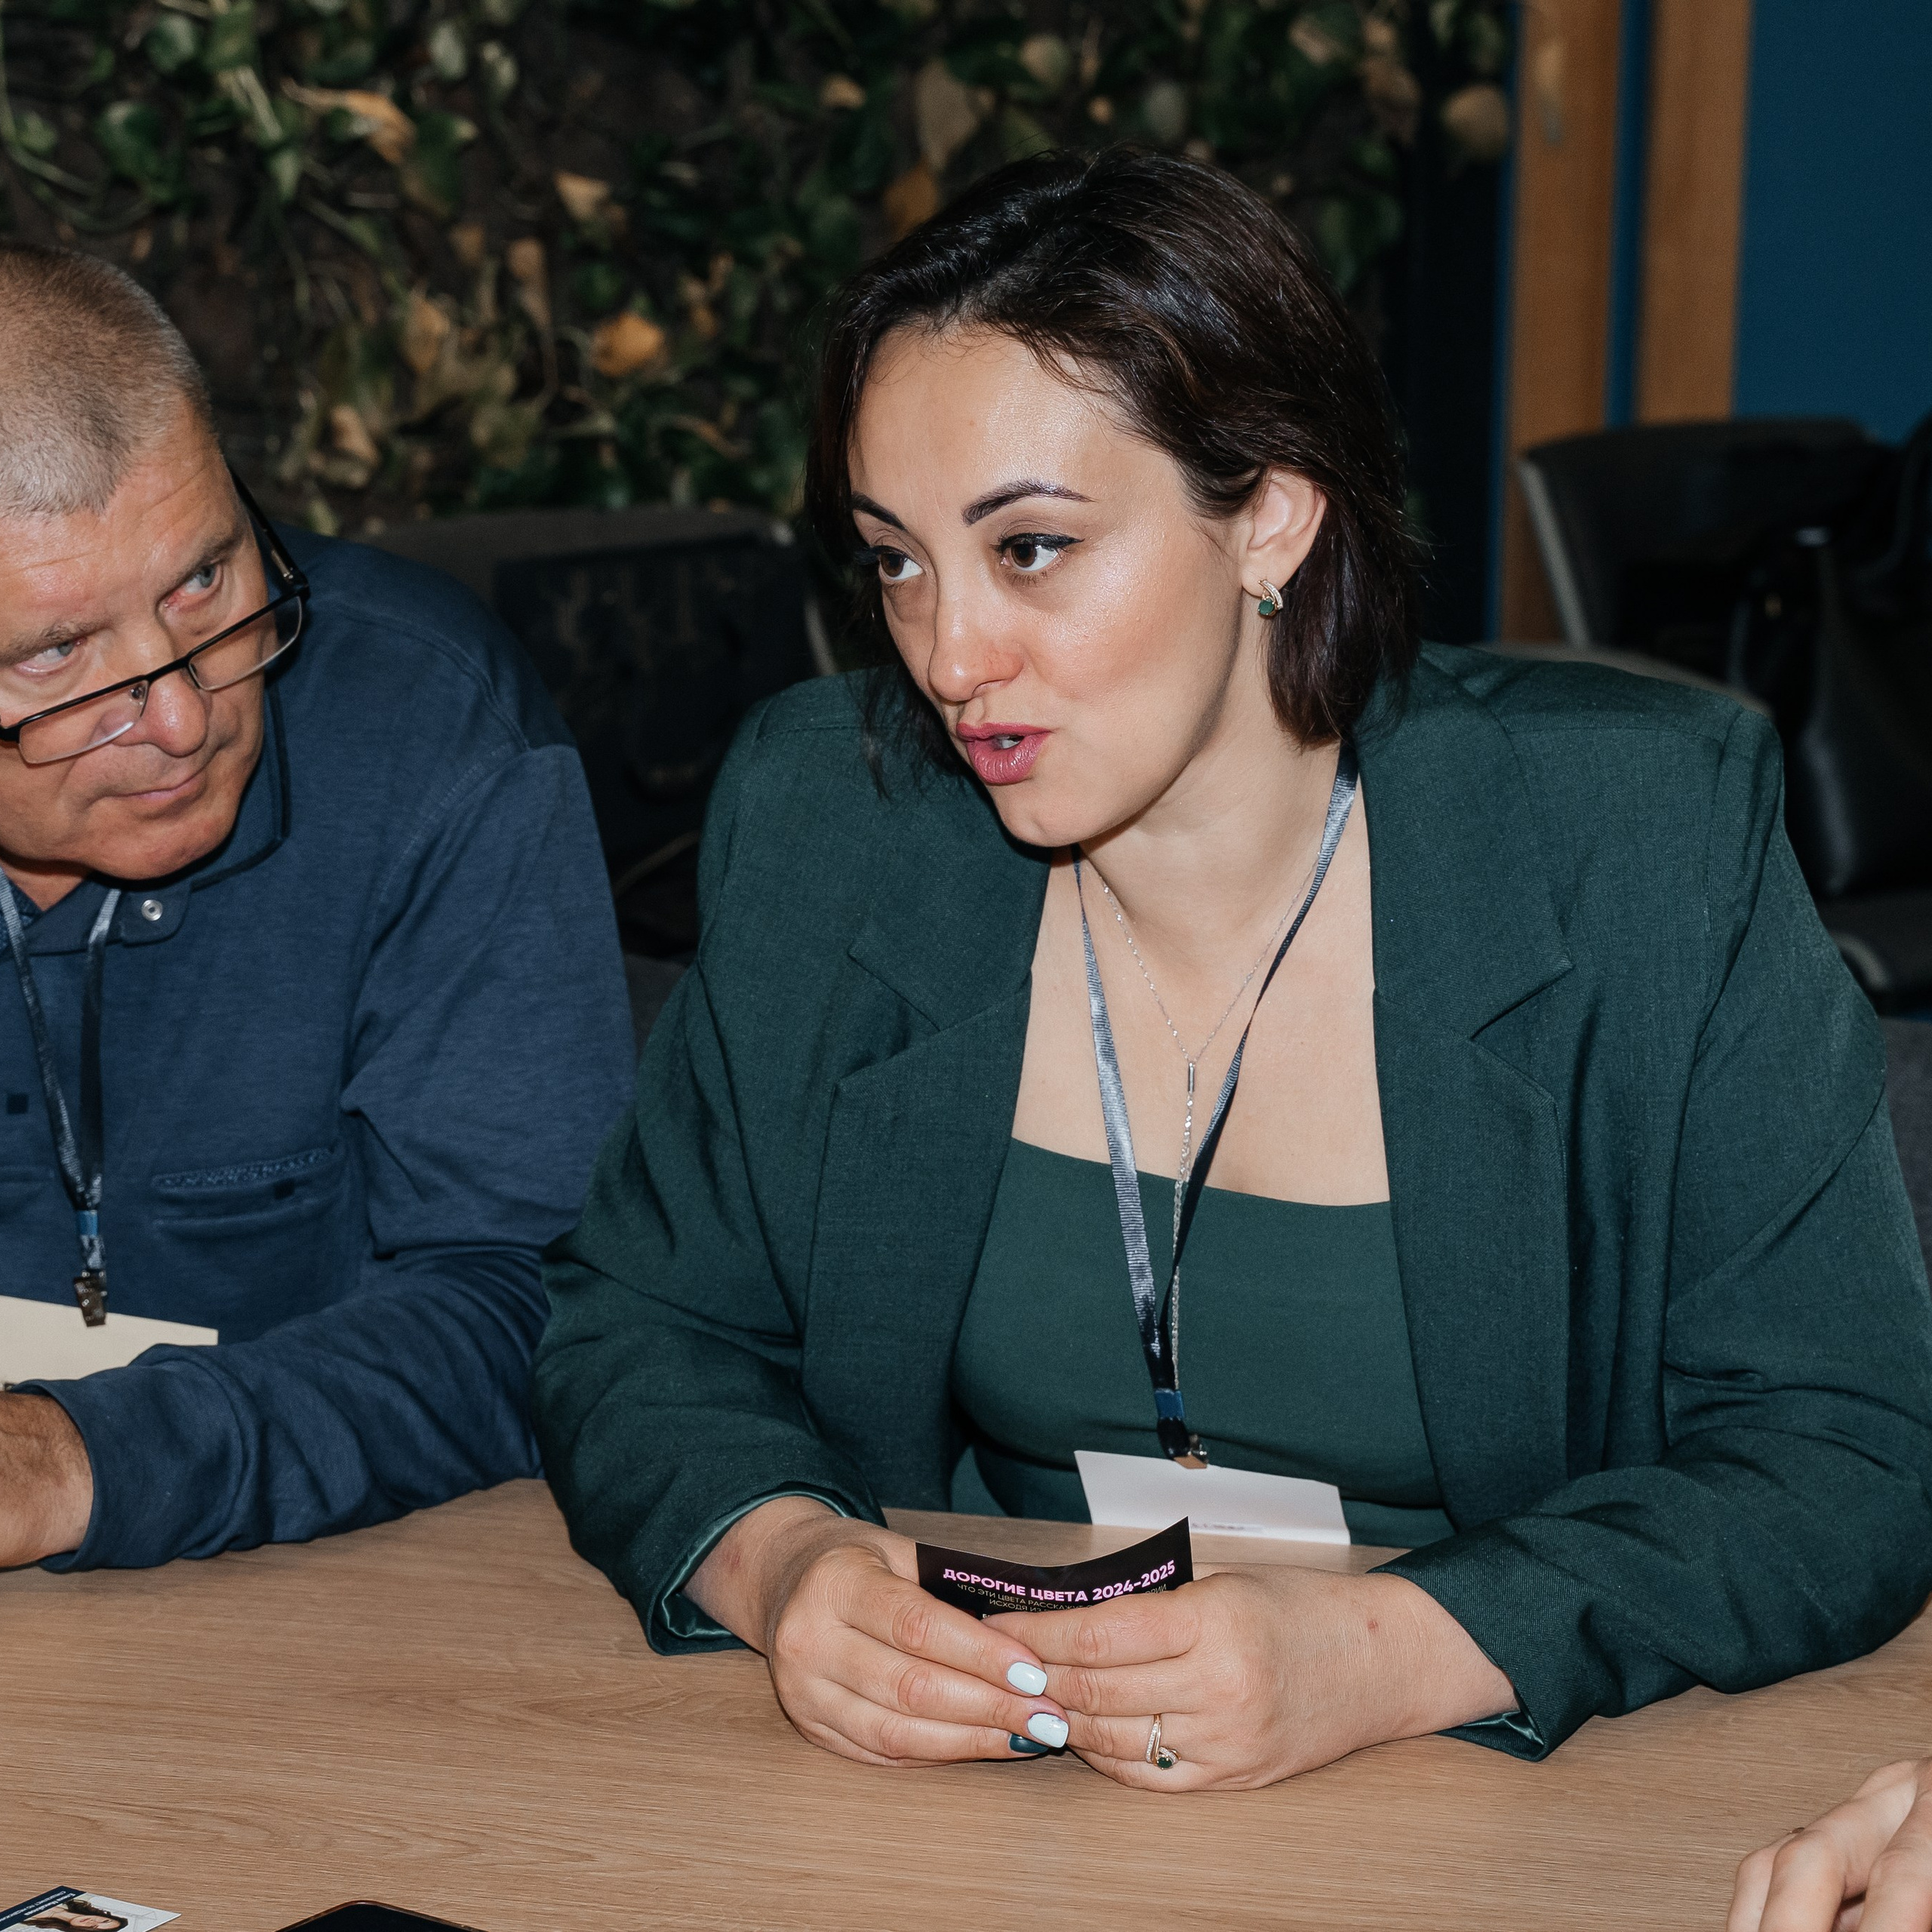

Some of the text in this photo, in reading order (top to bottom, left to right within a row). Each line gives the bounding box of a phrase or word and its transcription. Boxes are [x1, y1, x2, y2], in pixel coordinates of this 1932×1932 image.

[943, 1560, 1176, 1602] ДОРОГИЕ ЦВЕТА 2024-2025
[957, 1583, 976, 1593] ЧТО
[977, 1589, 996, 1598] ЭТИ
[998, 1594, 1026, 1604] ЦВЕТА
[989, 1598, 1028, 1611] ИСХОДЯ
